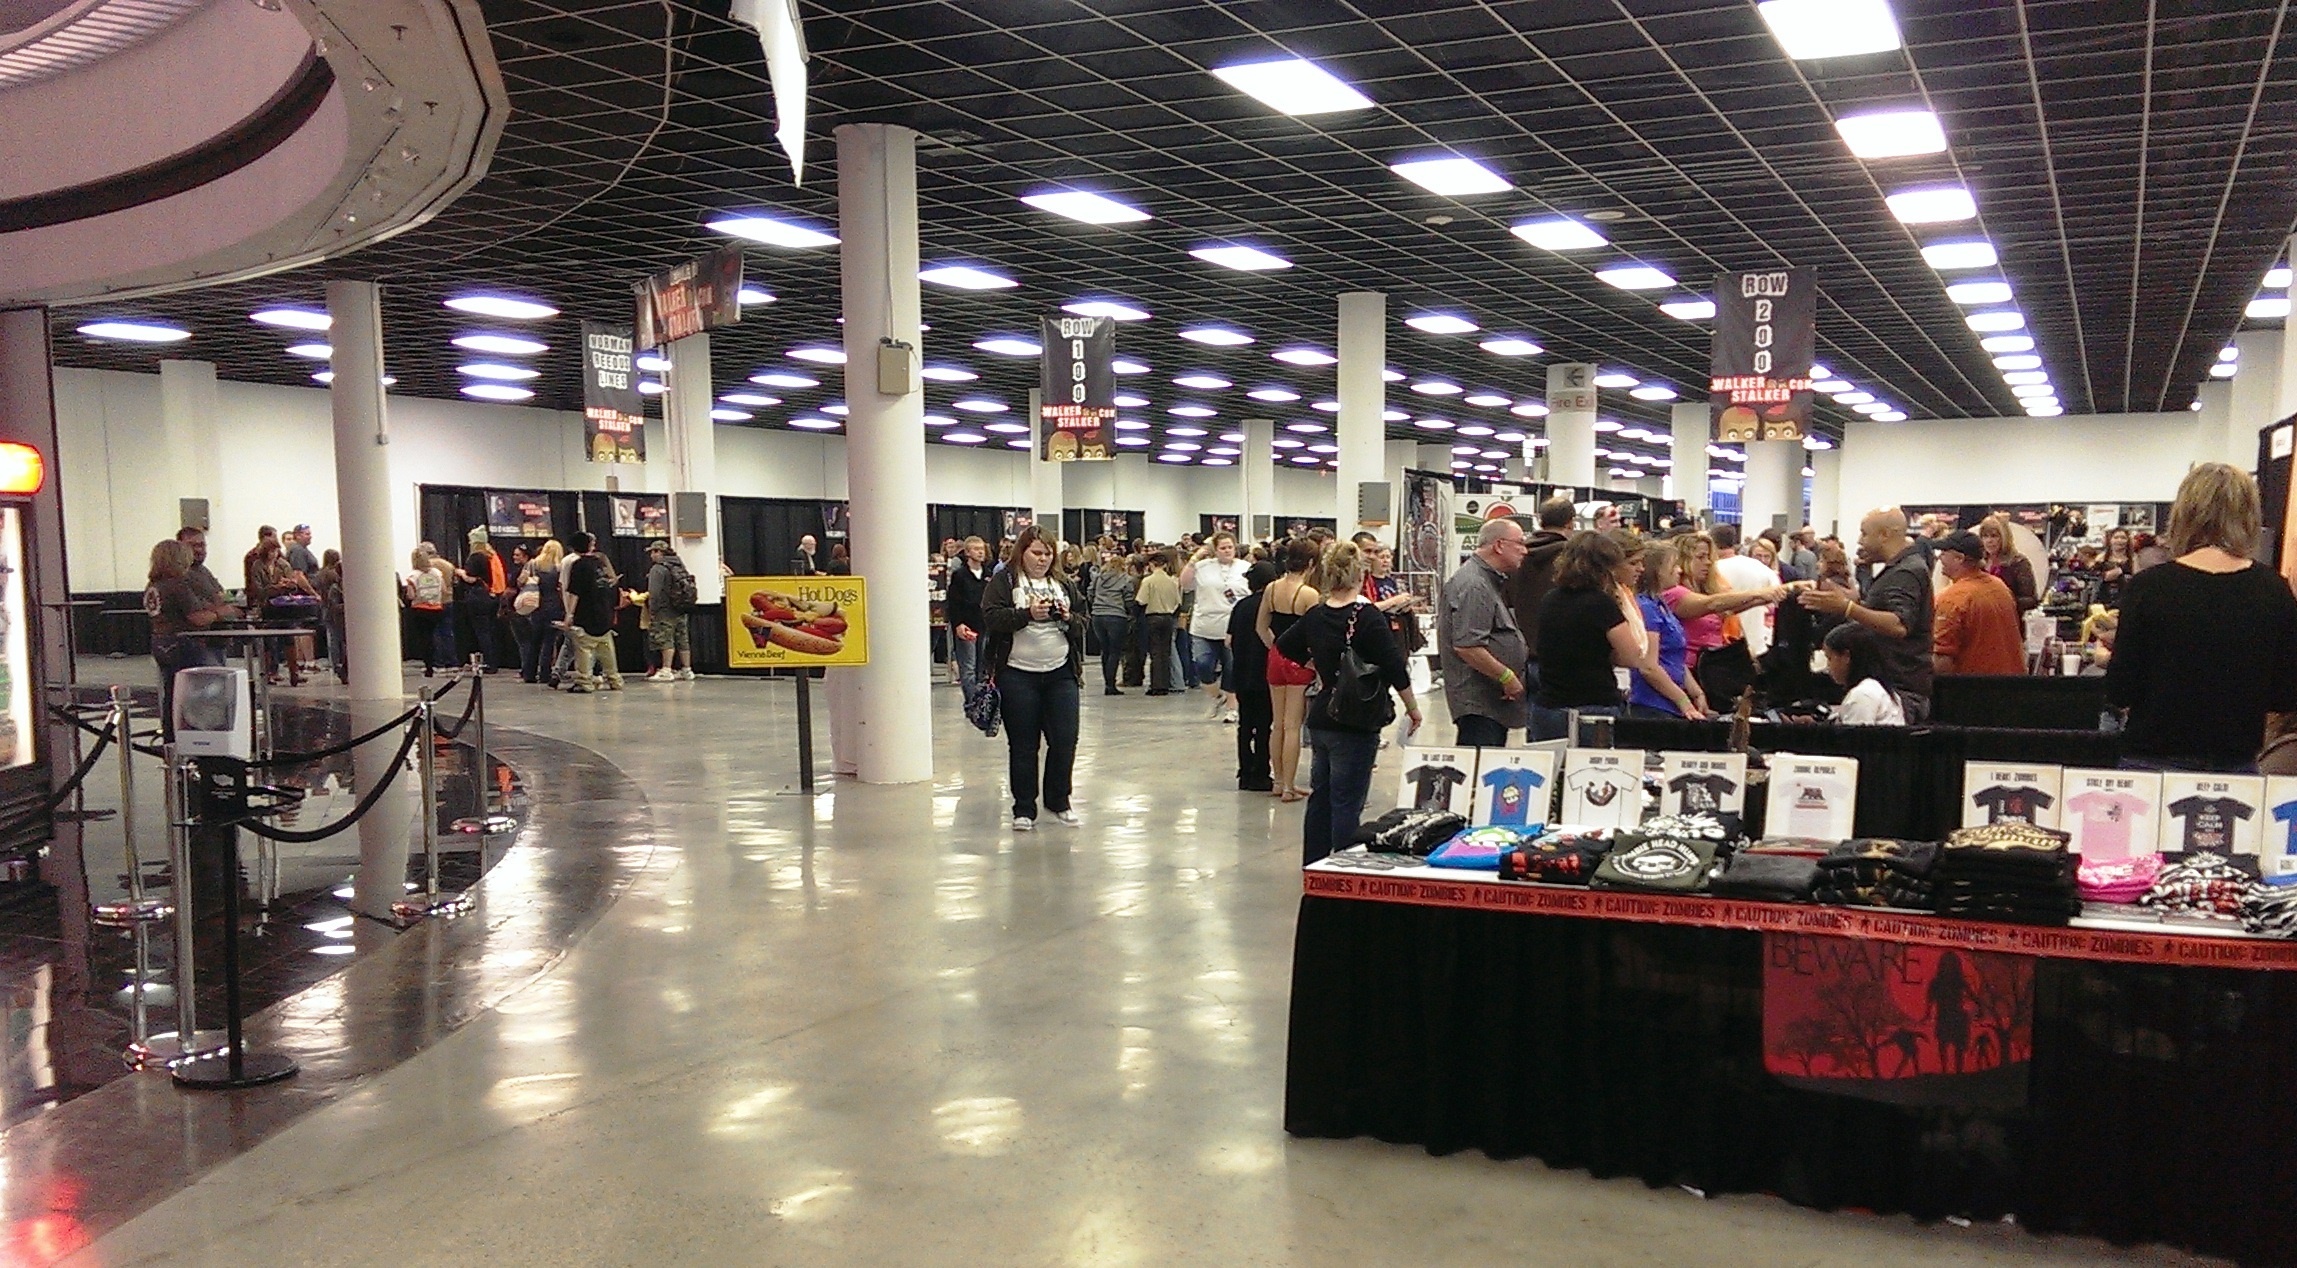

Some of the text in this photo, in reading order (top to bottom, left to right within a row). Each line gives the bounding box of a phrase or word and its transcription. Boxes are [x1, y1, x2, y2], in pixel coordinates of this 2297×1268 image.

[1742, 274, 1788, 297] ROW
[1061, 318, 1095, 338] ROW
[589, 334, 632, 353] NORMAN
[598, 370, 628, 389] LINES
[1711, 378, 1813, 390] WALKER CON
[1731, 390, 1790, 402] STALKER
[1042, 406, 1082, 418] WALKER
[1058, 418, 1100, 428] STALKER
[1462, 536, 1479, 544] AT
[798, 586, 858, 606] Hot Dogs
[737, 650, 786, 660] Vienna Beef
[1651, 839, 1678, 848] HEAD
[1309, 876, 1352, 892] ZOMBIES
[1420, 885, 1466, 901] ZOMBIES
[1537, 893, 1587, 910] ZOMBIES
[1662, 902, 1715, 918] ZOMBIES
[1797, 910, 1852, 929] ZOMBIES
[1939, 923, 2000, 944] ZOMBIES
[2090, 936, 2153, 955] ZOMBIES
[1771, 934, 1924, 985] BEWARE
